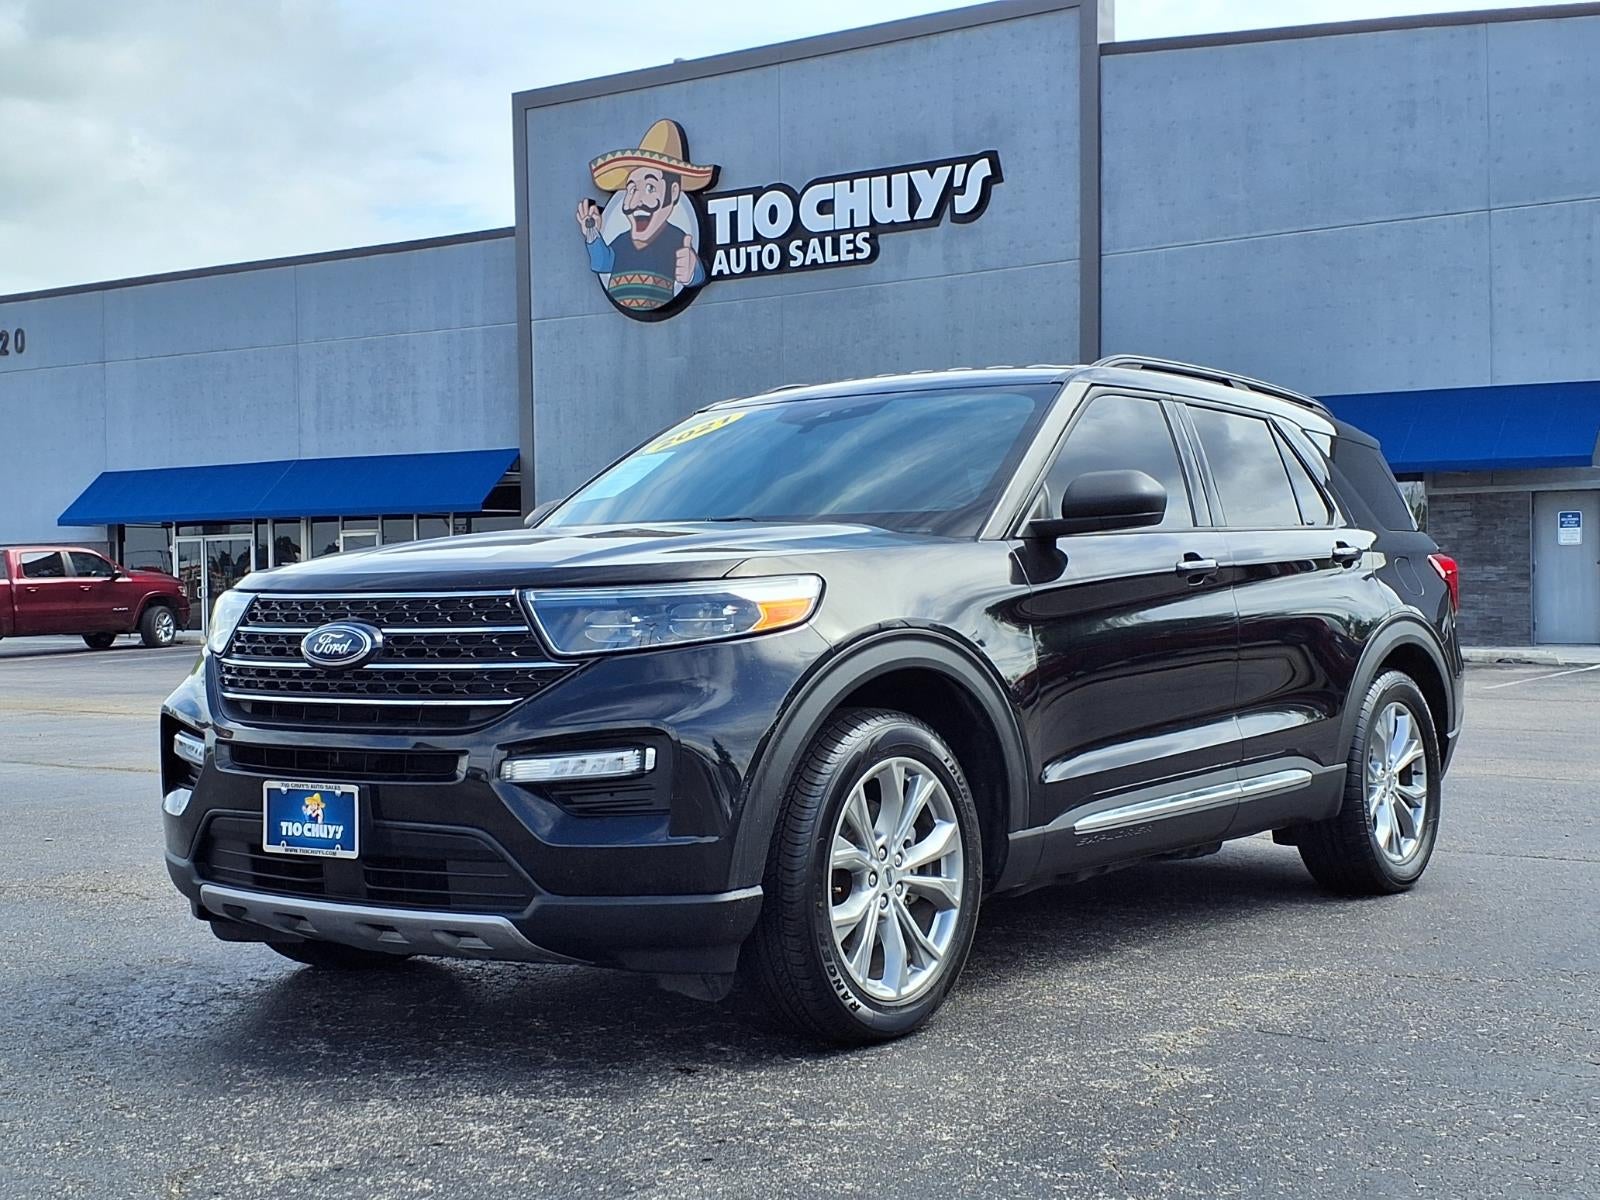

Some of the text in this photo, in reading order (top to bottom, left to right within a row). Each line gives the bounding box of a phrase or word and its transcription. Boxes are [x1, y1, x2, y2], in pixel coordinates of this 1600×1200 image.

[707, 157, 992, 245] TIO CHUY'S
[711, 231, 871, 276] AUTO SALES
[313, 632, 353, 655] Ford
[280, 821, 303, 836] TIO
